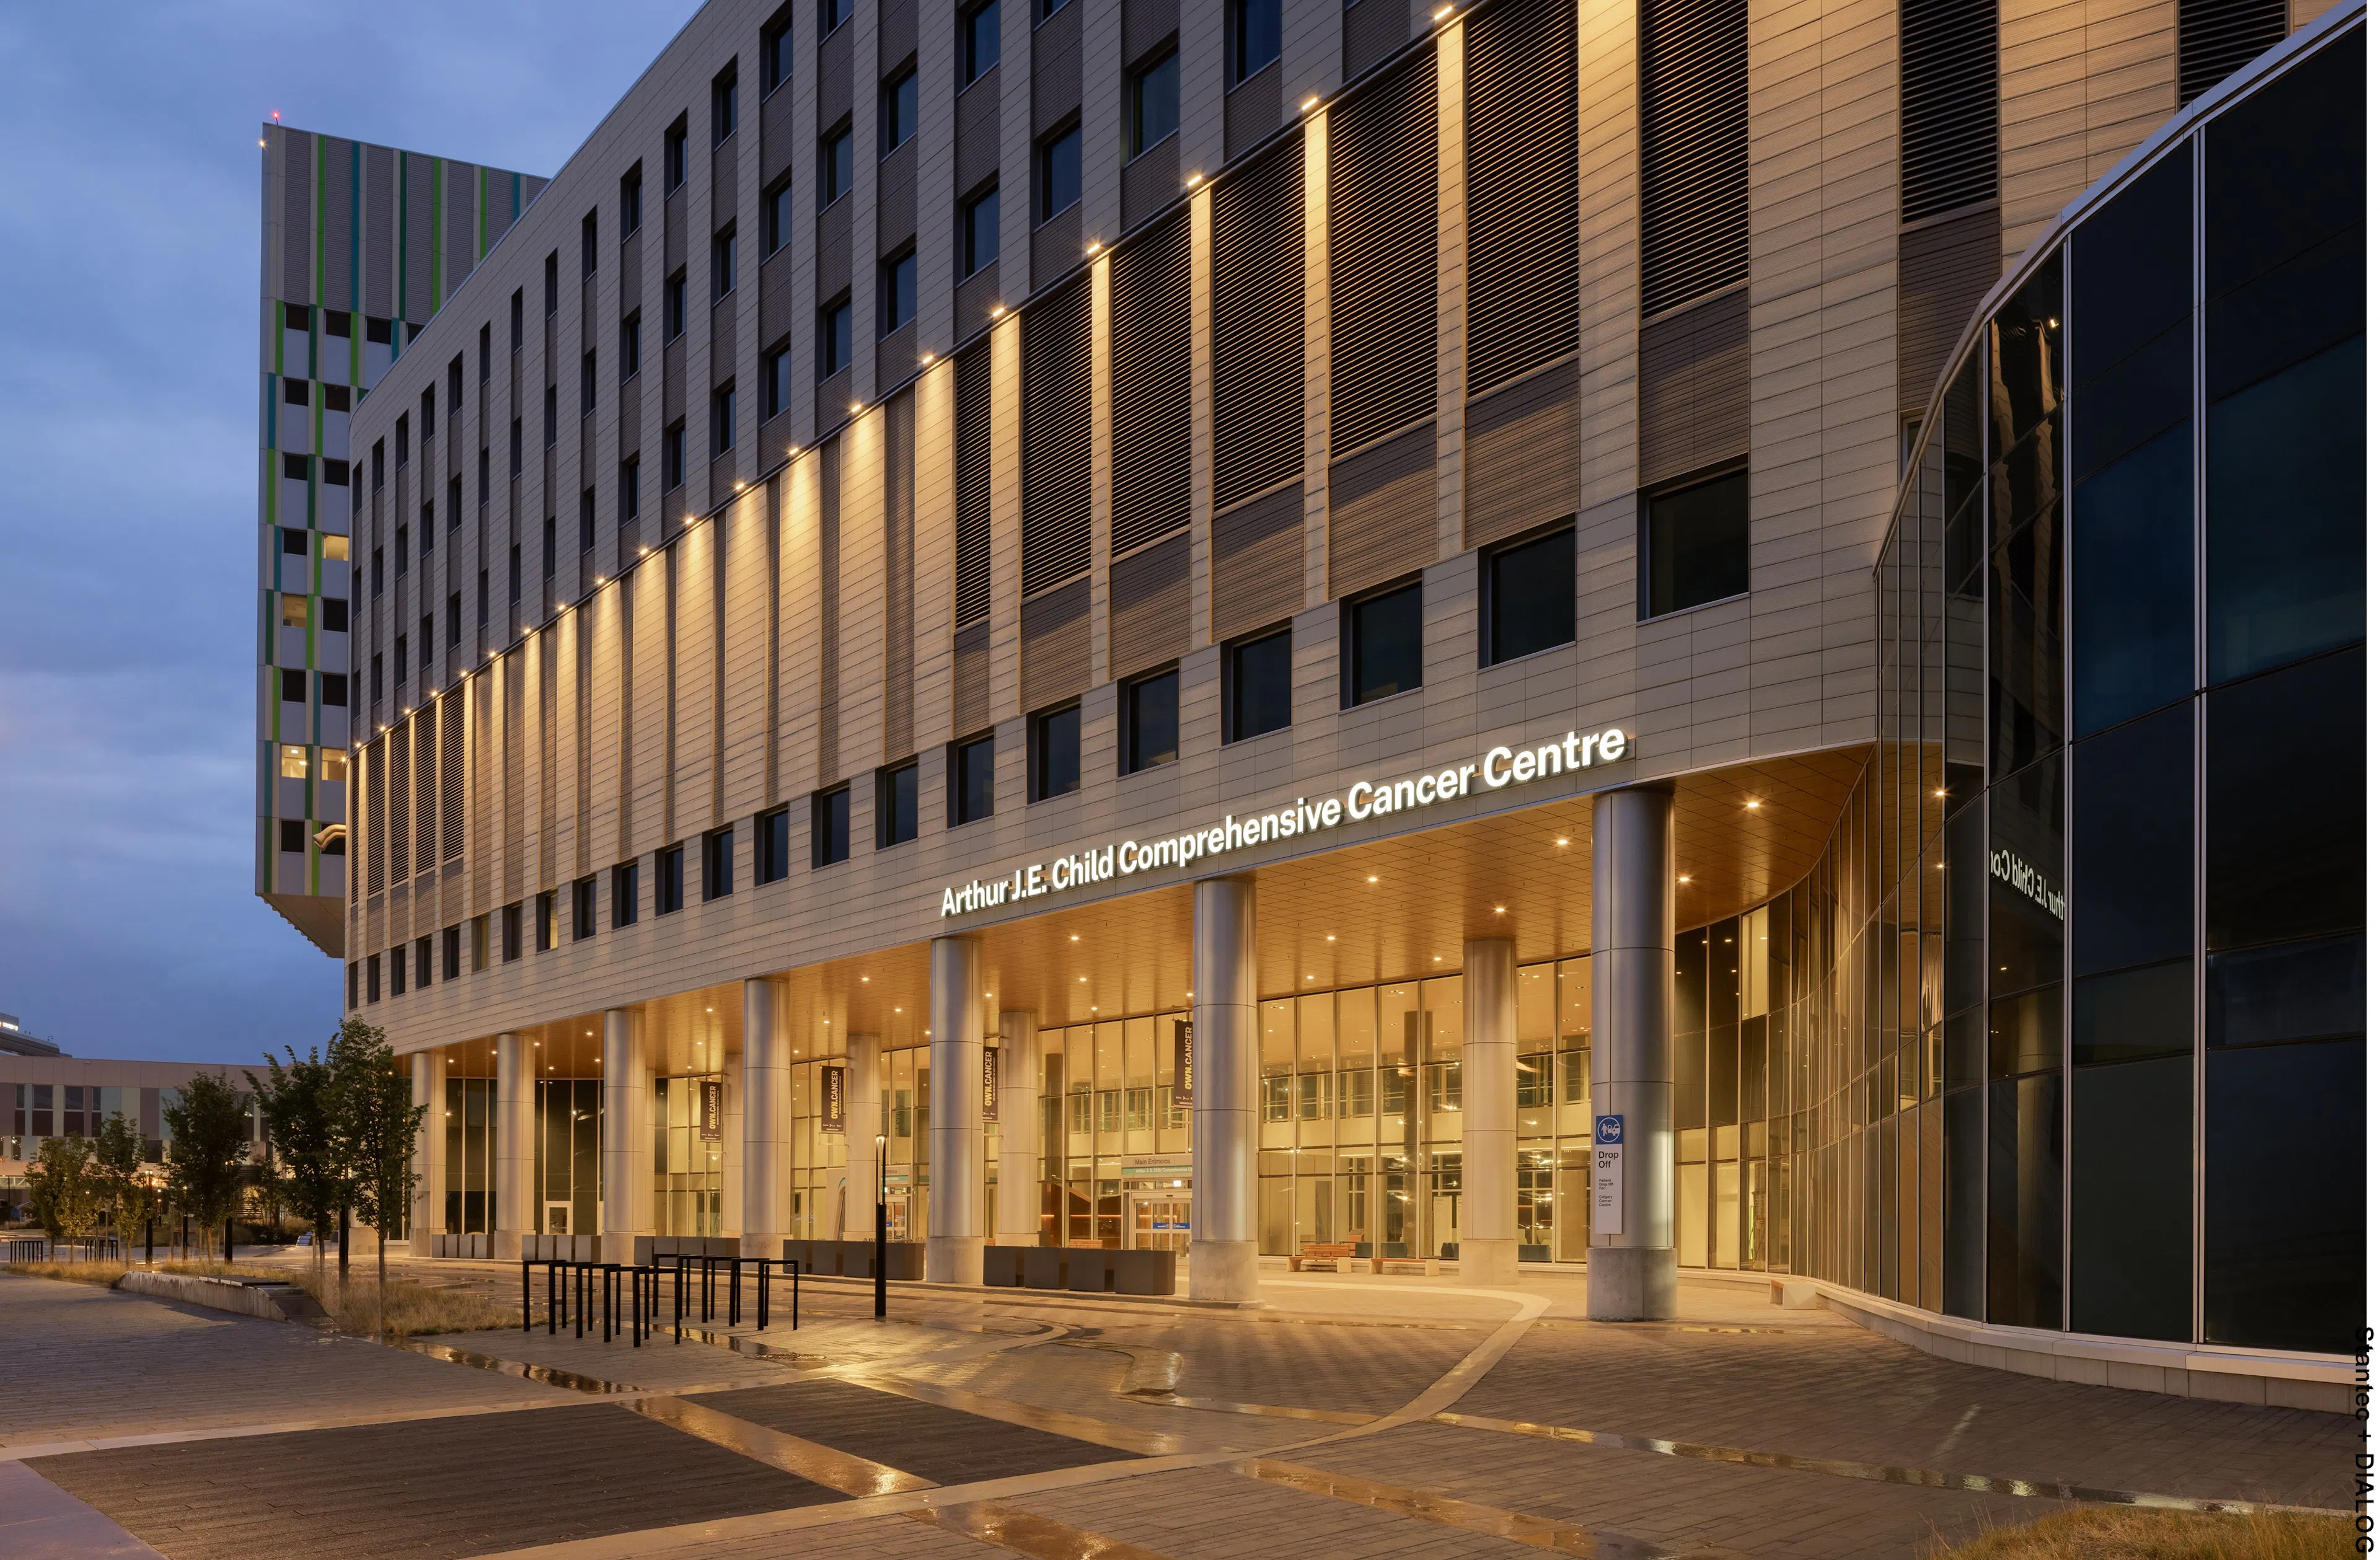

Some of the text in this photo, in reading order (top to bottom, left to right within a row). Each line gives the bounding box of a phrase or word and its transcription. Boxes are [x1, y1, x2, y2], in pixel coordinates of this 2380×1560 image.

[941, 729, 1625, 917] Arthur J.E. Child Comprehensive Cancer Centre
[1184, 1026, 1192, 1090] OWN.CANCER
[1598, 1151, 1619, 1160] Drop
[1598, 1160, 1611, 1168] Off
